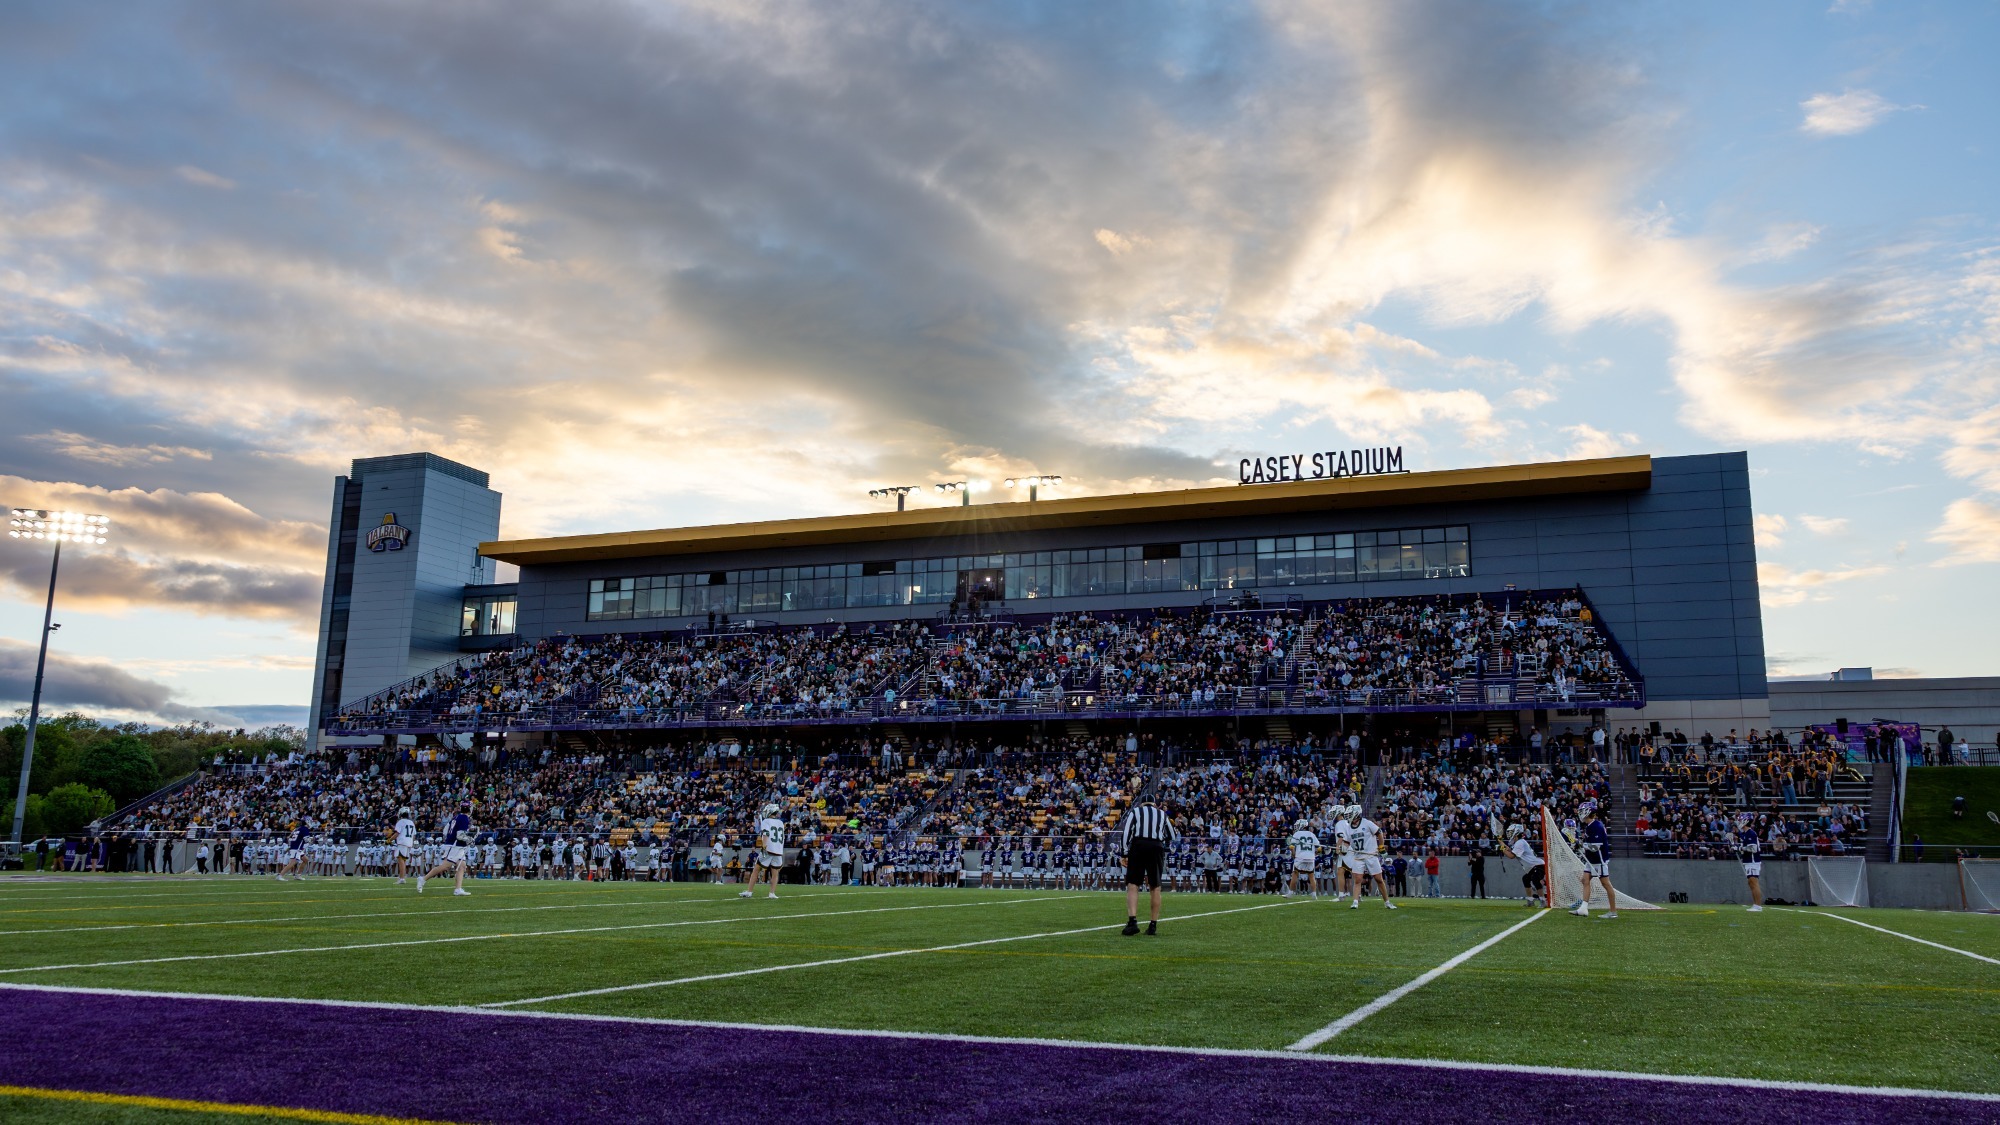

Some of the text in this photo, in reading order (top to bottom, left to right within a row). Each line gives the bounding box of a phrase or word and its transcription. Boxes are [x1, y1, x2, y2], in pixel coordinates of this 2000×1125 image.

[1240, 446, 1403, 484] CASEY STADIUM
[405, 824, 414, 838] 17
[770, 826, 784, 845] 33
[1353, 838, 1365, 851] 37
